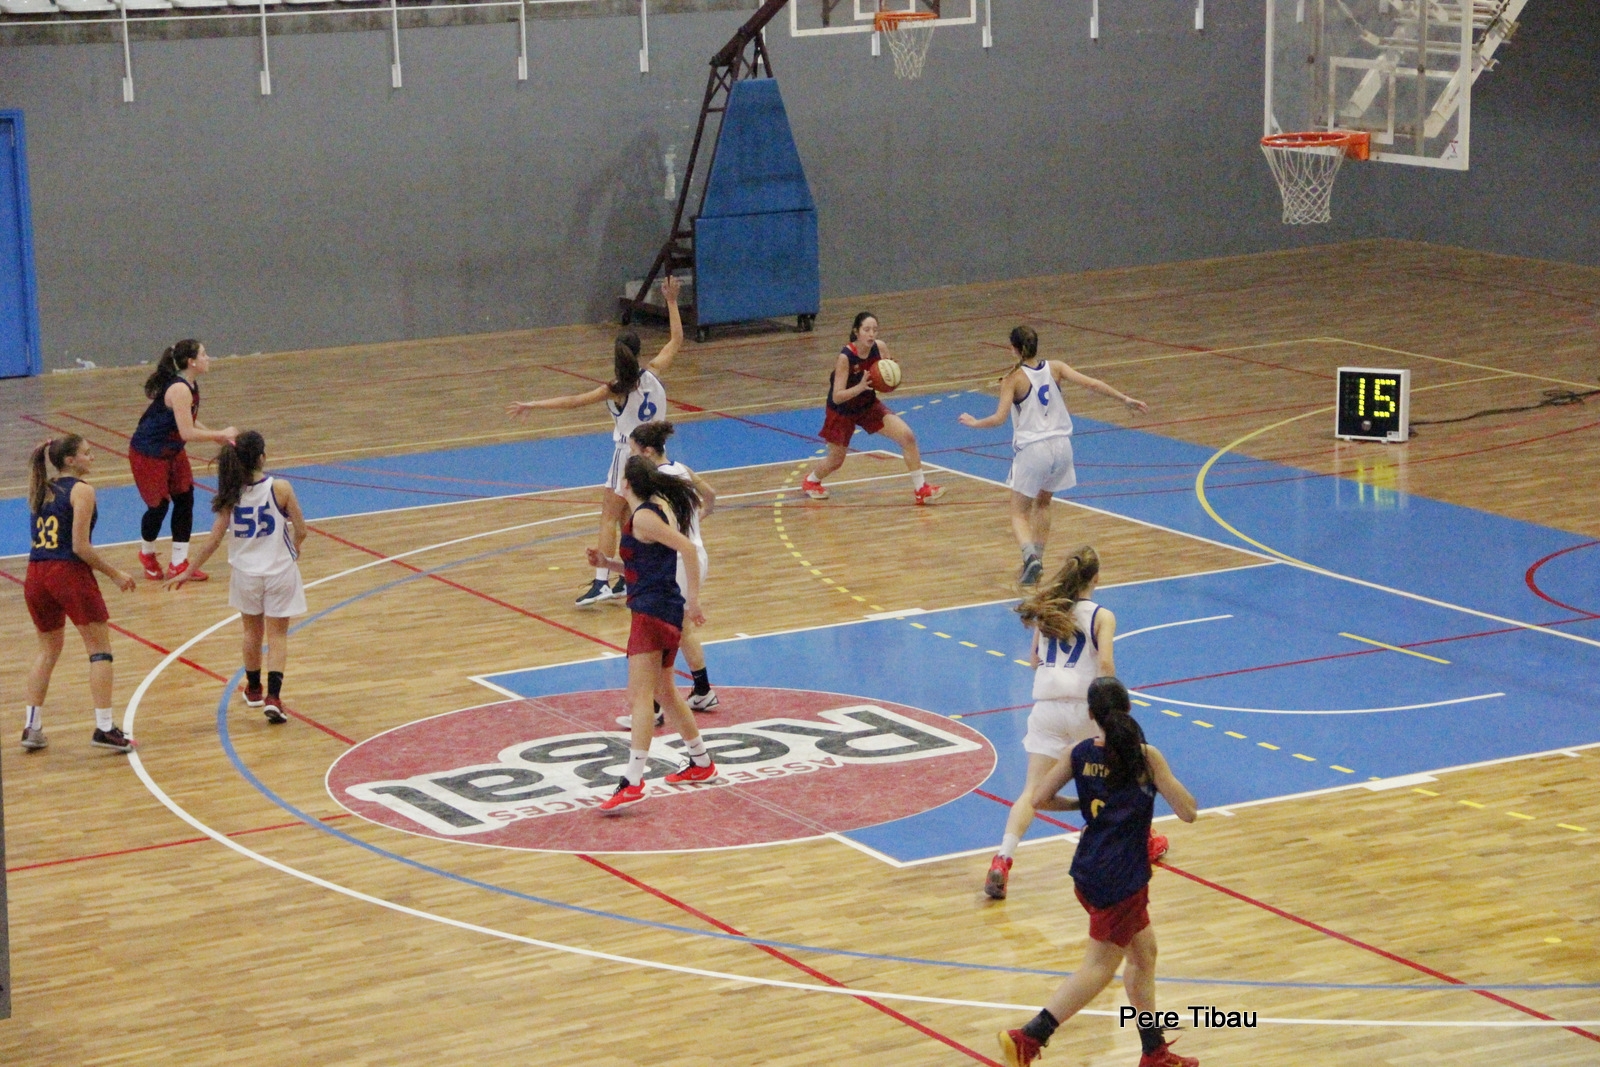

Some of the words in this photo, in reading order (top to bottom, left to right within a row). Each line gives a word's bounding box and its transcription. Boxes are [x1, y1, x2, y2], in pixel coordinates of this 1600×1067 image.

[637, 391, 658, 422] 6
[1358, 377, 1396, 418] 15
[34, 515, 59, 549] 33
[233, 500, 276, 539] 55
[1045, 629, 1087, 669] 19
[369, 708, 957, 829] Regal
[487, 756, 836, 822] ASSEGURNCES
